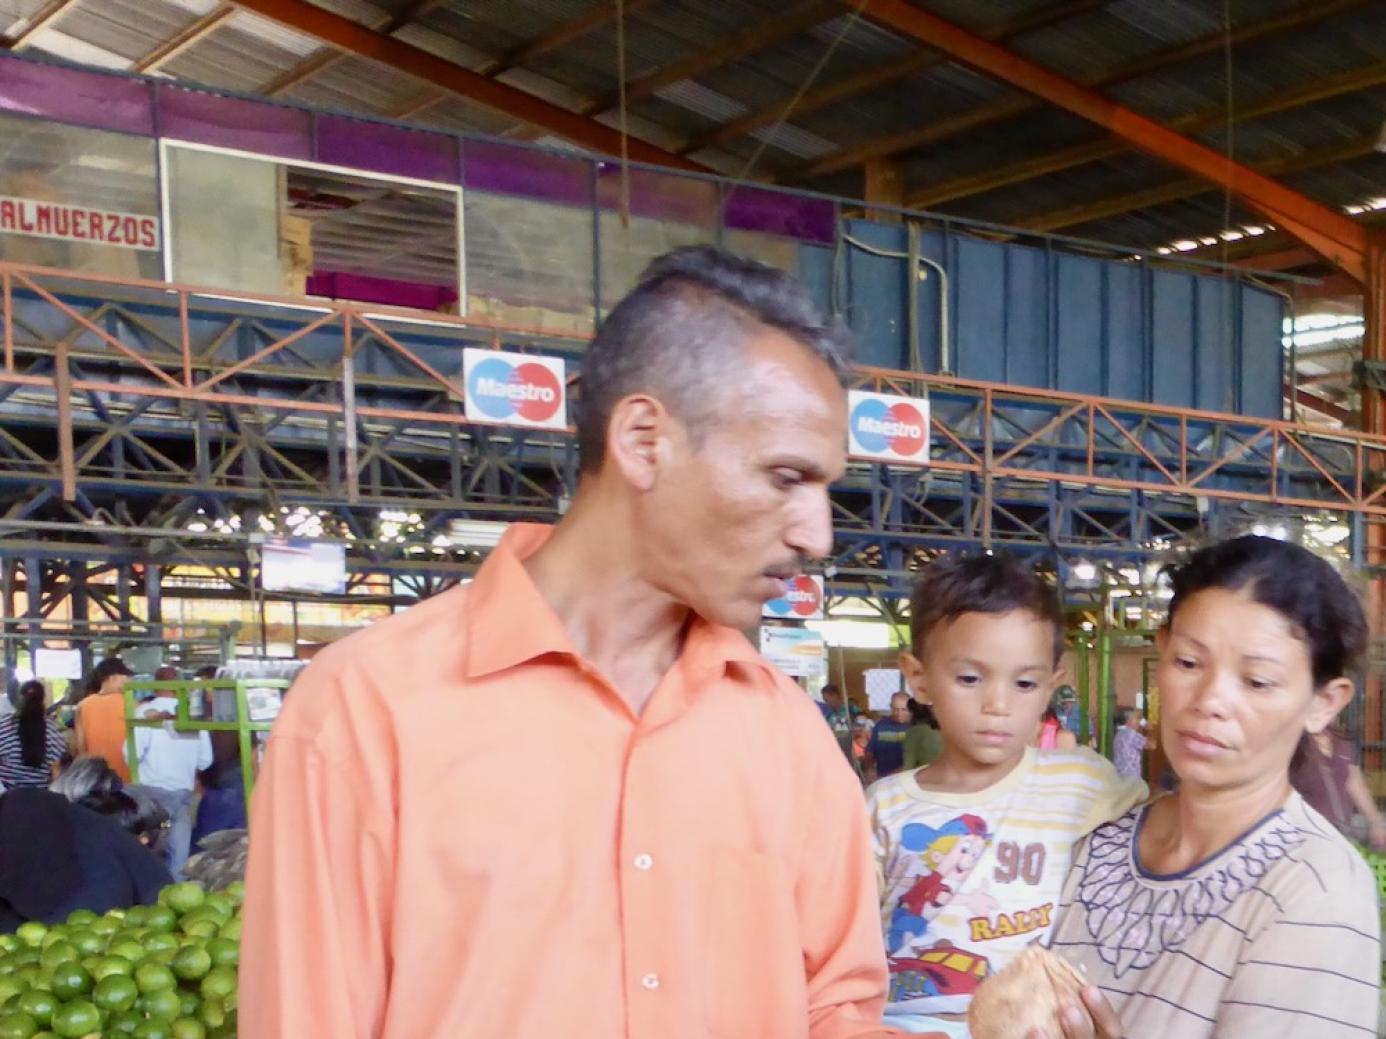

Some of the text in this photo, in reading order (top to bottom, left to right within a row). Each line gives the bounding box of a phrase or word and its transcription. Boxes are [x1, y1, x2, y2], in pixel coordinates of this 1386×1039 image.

[0, 200, 155, 248] ALMUERZOS
[476, 376, 555, 403] Maestro
[857, 415, 921, 439] Maestro
[993, 841, 1046, 886] 90
